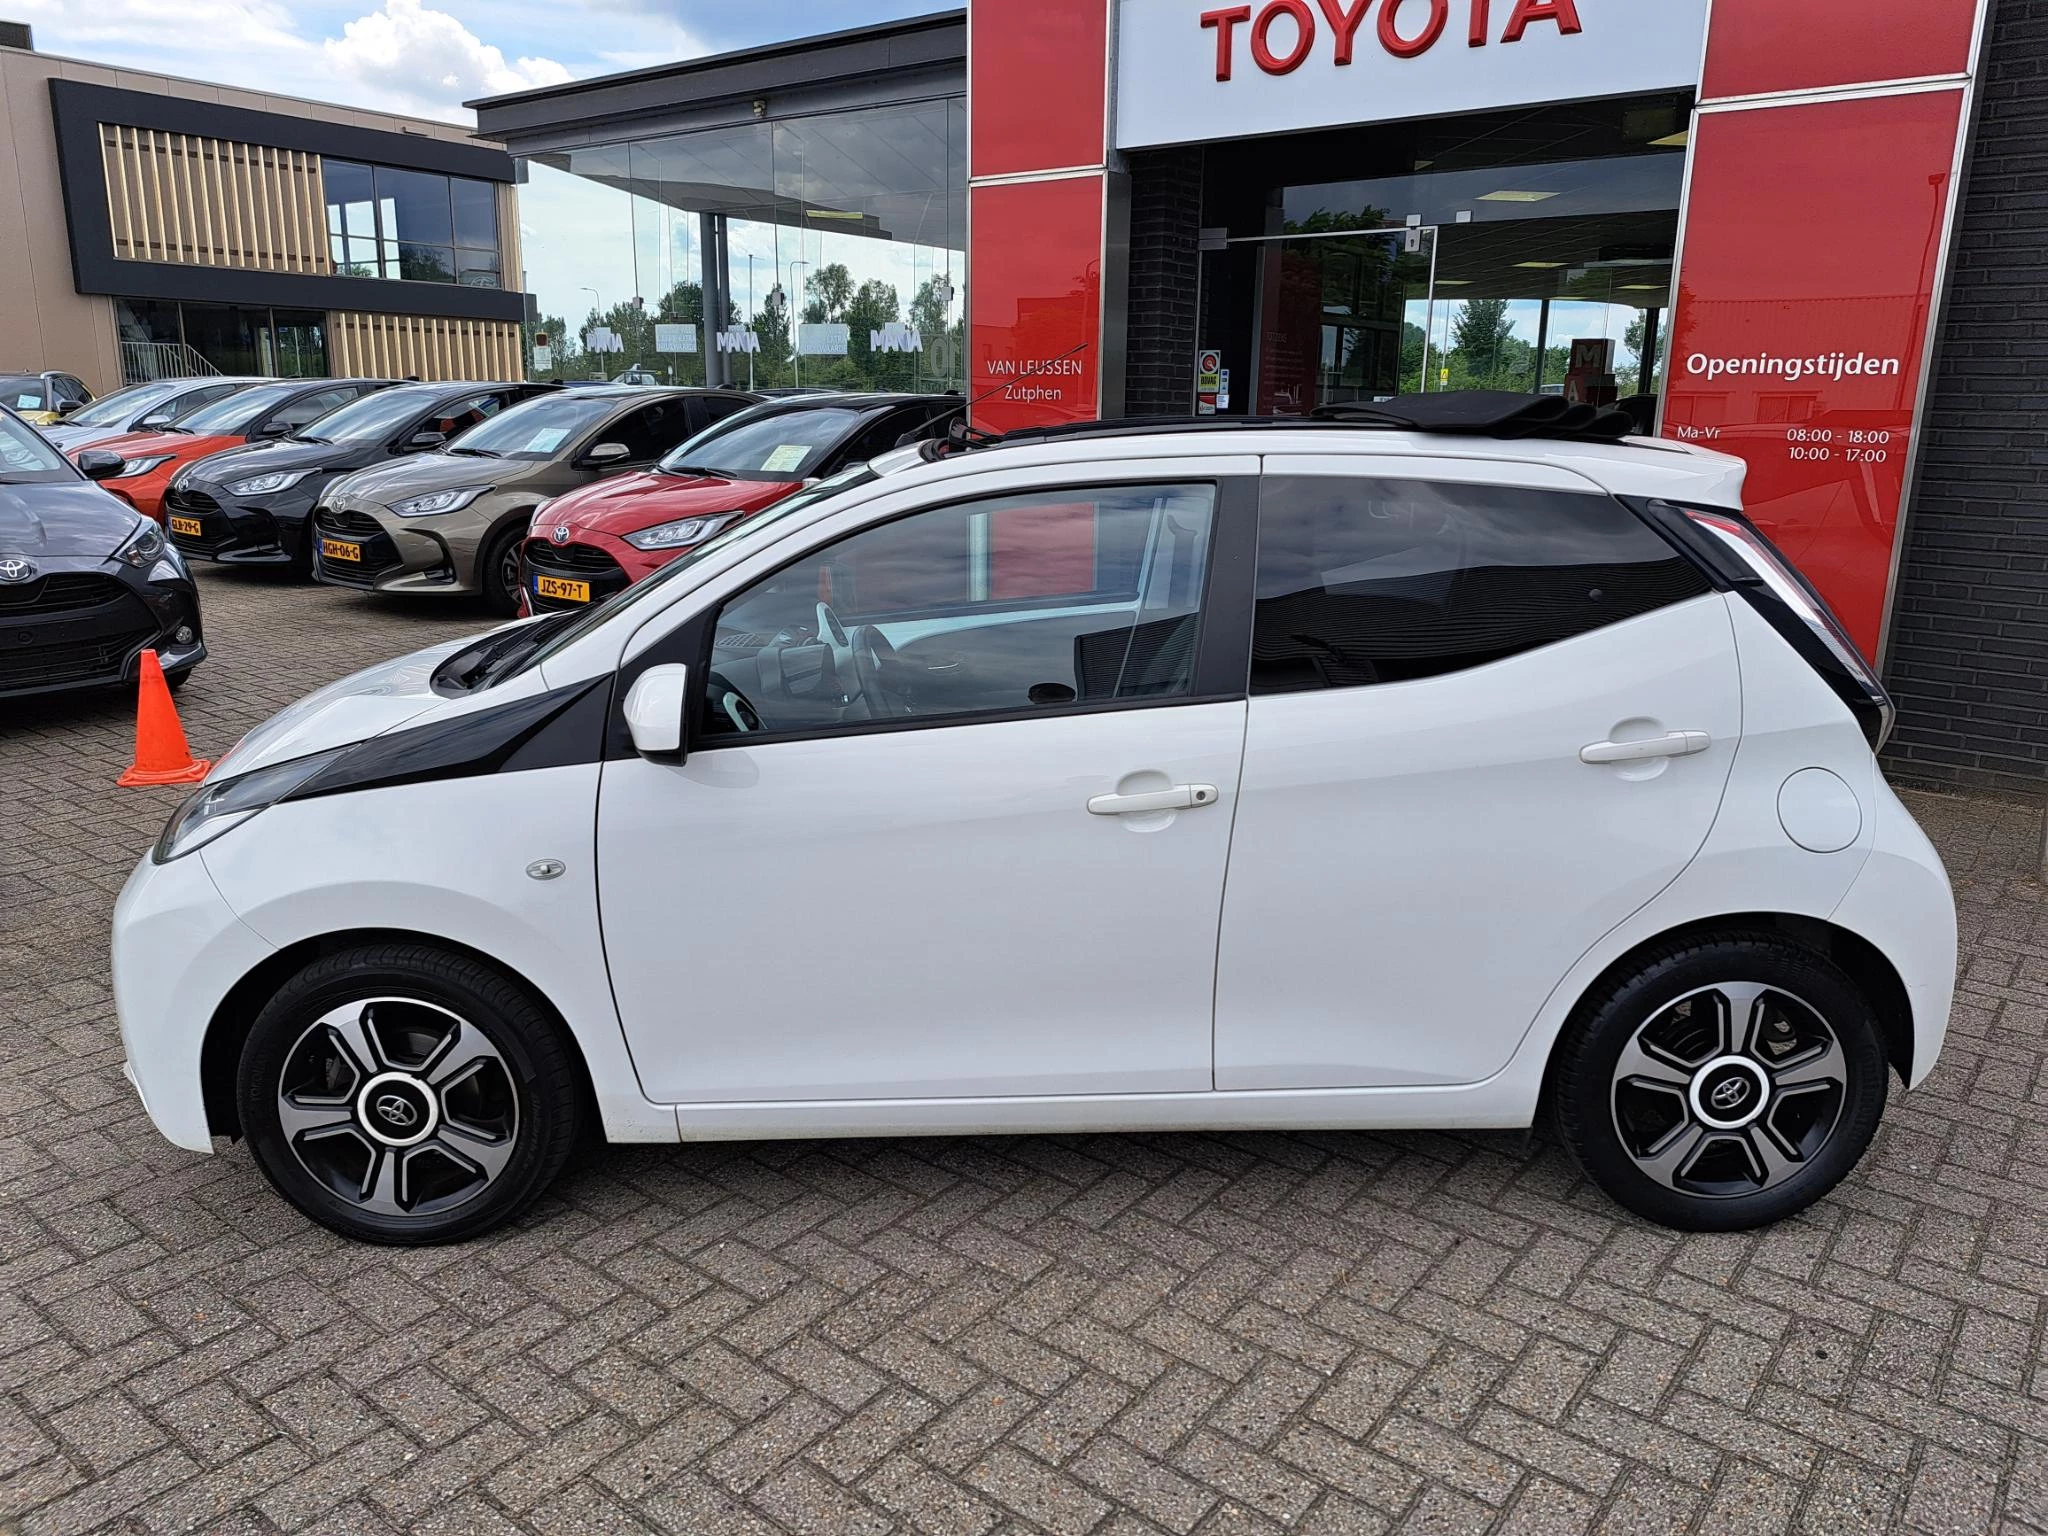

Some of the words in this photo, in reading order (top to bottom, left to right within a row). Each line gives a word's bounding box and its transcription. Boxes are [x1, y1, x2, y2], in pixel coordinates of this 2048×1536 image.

[987, 360, 1015, 374] VAN
[1020, 360, 1082, 375] LEUSSEN
[1686, 352, 1899, 381] Openingstijden
[1005, 385, 1062, 403] Zutphen
[1677, 426, 1721, 439] Ma-Vr
[1786, 428, 1832, 442] 08:00
[1848, 430, 1890, 444] 18:00
[1788, 446, 1830, 460] 10:00
[1845, 449, 1887, 463] 17:00
[541, 579, 583, 599] JZS-97-T
